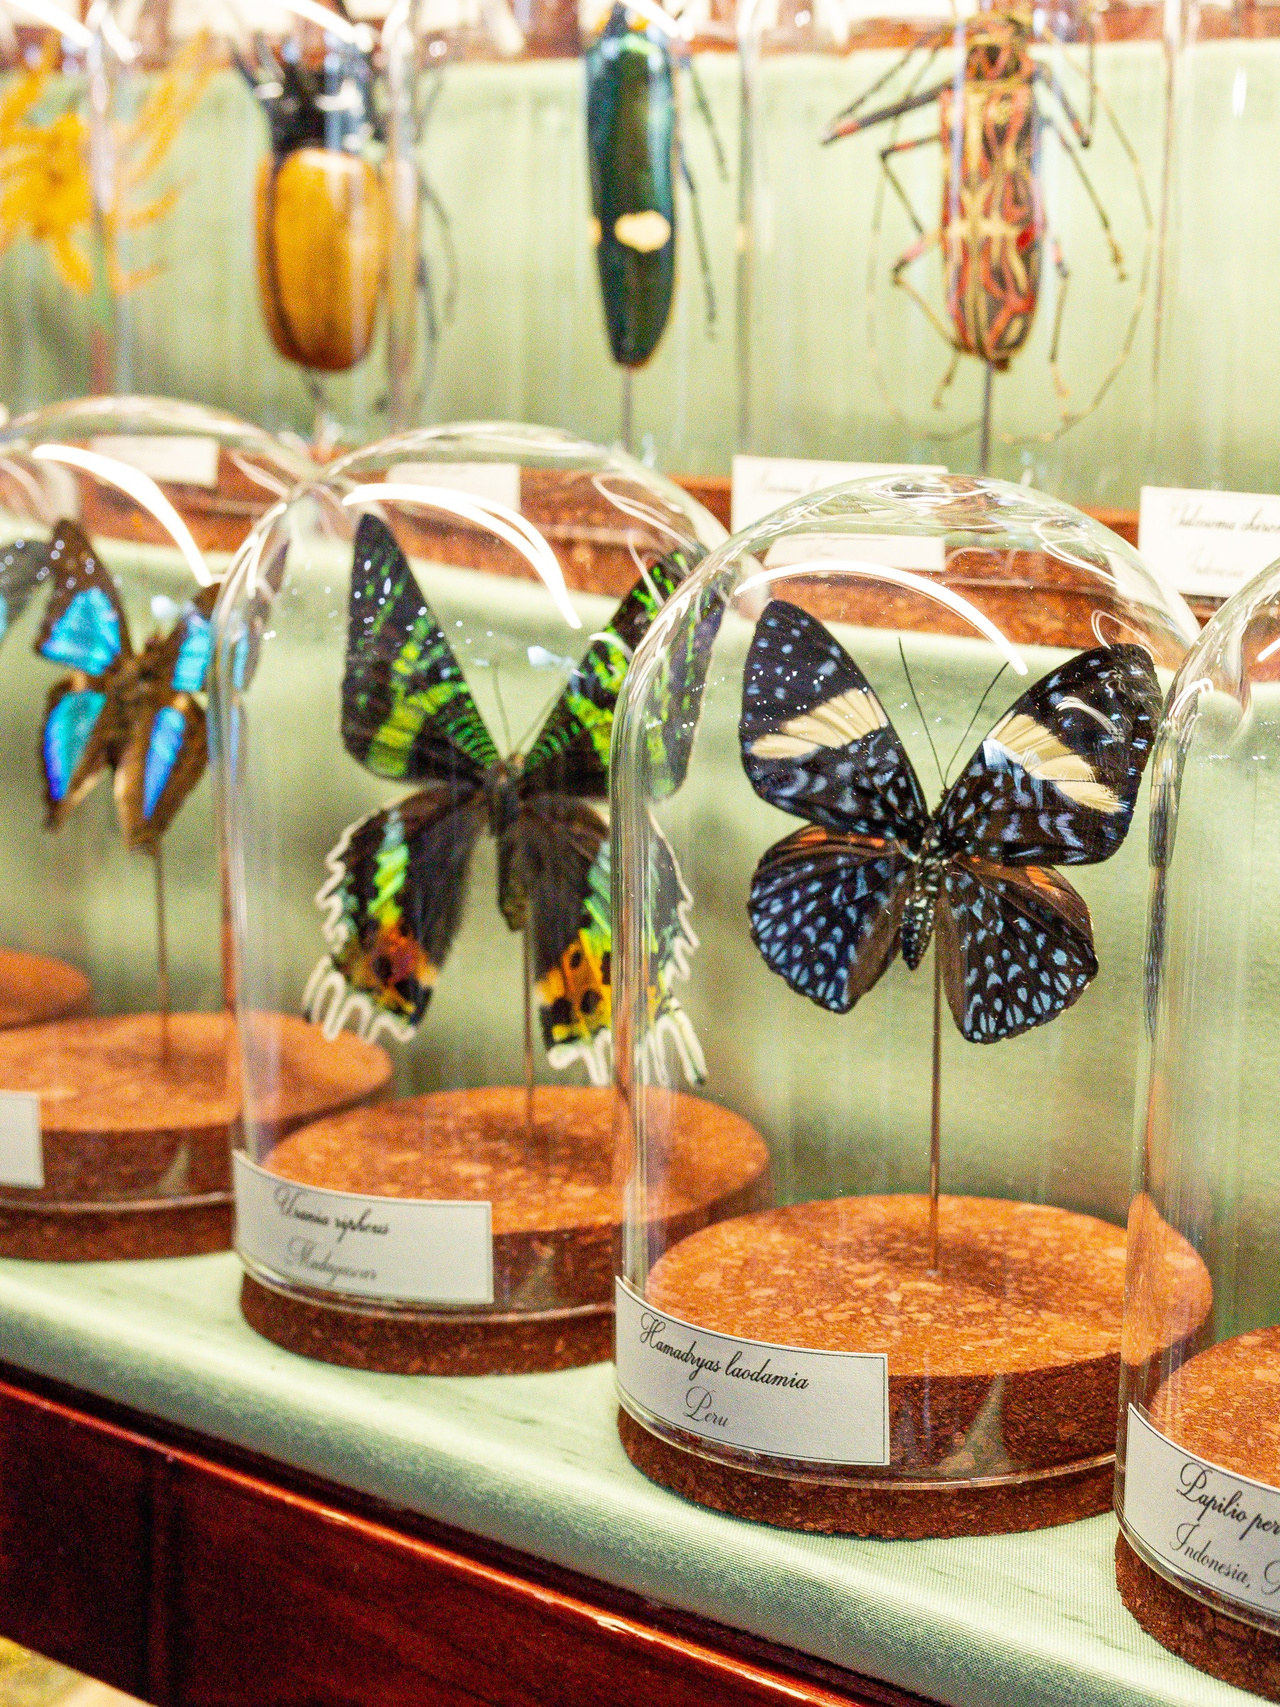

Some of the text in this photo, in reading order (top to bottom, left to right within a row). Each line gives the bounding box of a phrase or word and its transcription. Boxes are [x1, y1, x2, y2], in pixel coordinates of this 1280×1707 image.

[640, 1312, 810, 1391] Hamadryas laodamia
[682, 1386, 729, 1428] Peru
[1176, 1461, 1247, 1522] Papilio
[1169, 1522, 1252, 1590] Indonesia,
